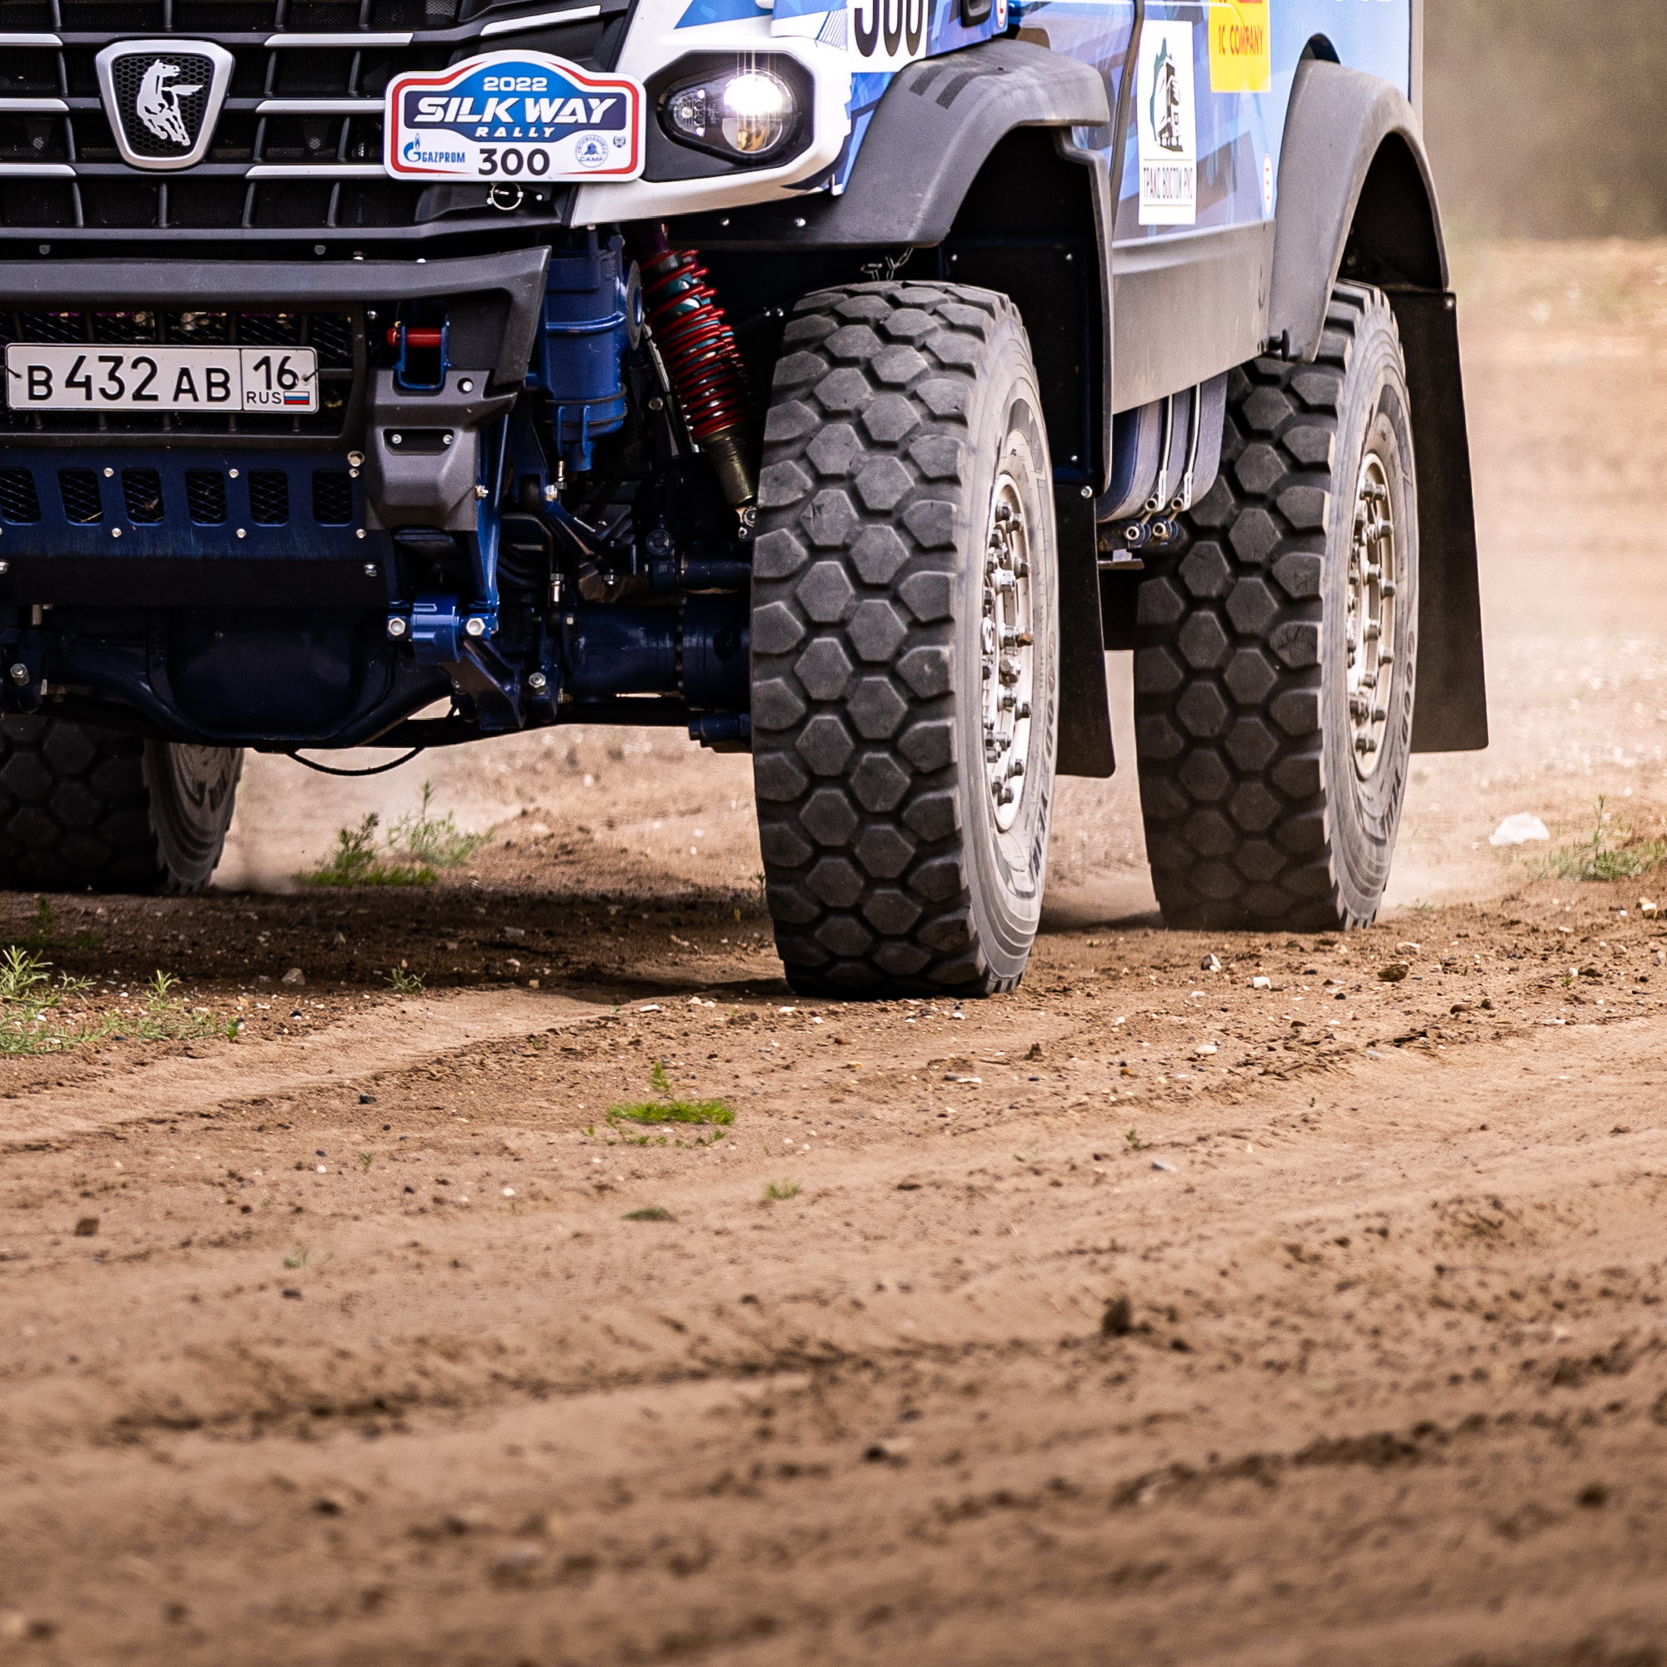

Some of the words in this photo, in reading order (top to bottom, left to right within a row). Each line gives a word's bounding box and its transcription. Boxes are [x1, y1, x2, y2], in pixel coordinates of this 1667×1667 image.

[1229, 24, 1263, 57] COMPANY
[483, 76, 548, 92] 2022
[414, 97, 520, 123] SILK
[524, 97, 617, 124] WAY
[475, 126, 556, 138] RALLY
[421, 151, 466, 164] GAZPROM
[477, 147, 551, 176] 300
[252, 354, 300, 391] 16
[245, 391, 282, 405] RUS
